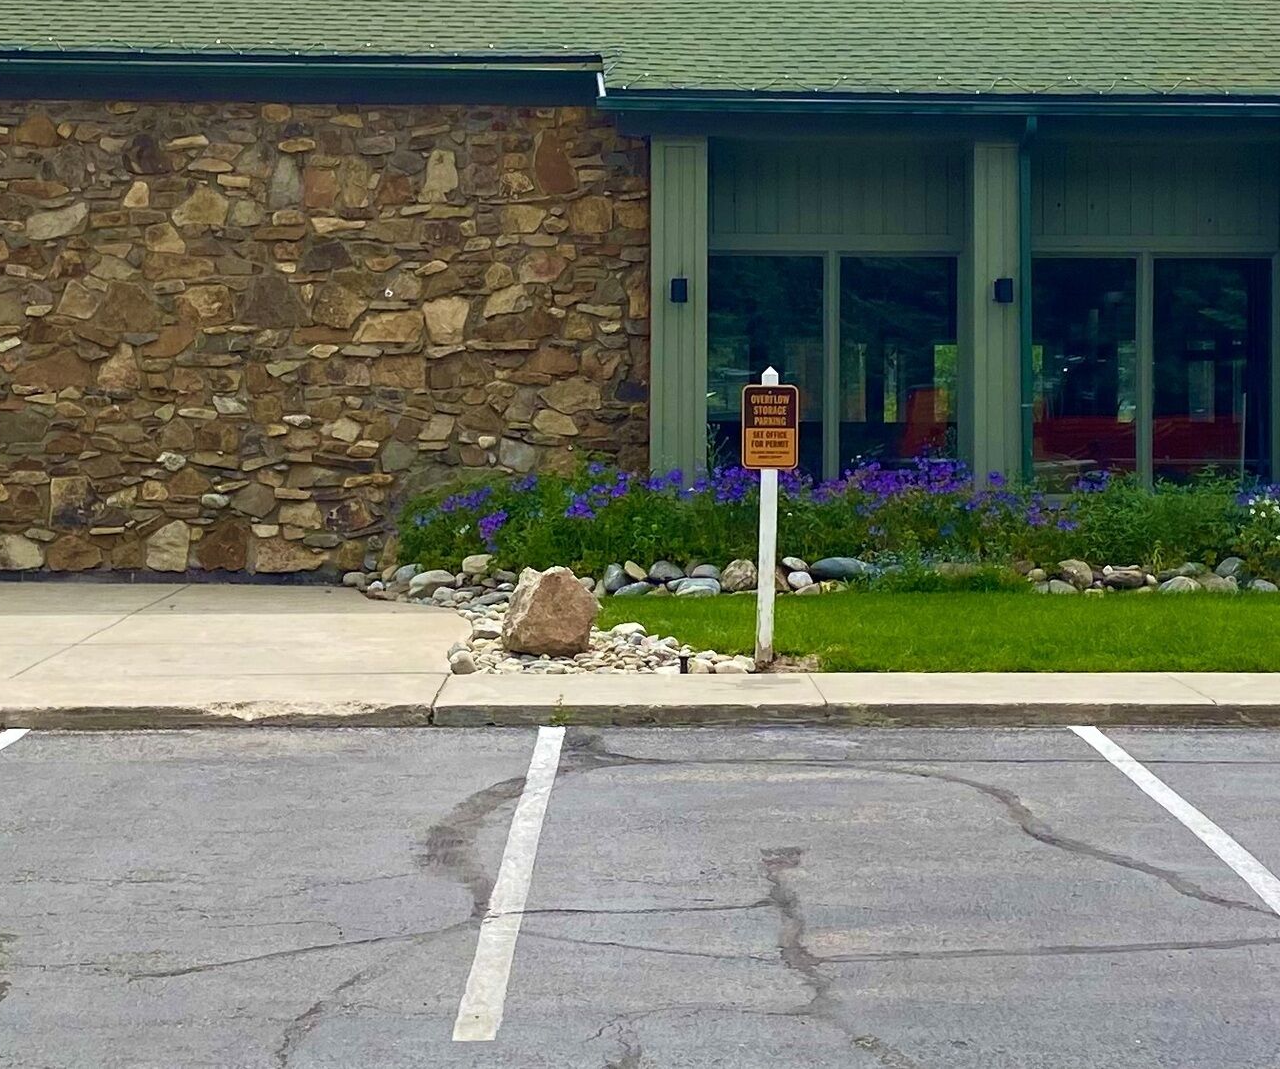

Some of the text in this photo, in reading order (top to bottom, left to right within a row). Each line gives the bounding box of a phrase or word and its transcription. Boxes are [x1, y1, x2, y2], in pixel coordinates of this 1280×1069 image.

[750, 394, 790, 404] OVERFLOW
[753, 406, 787, 415] STORAGE
[754, 416, 787, 426] PARKING
[765, 431, 787, 439] OFFICE
[751, 440, 789, 448] FOR PERMIT
